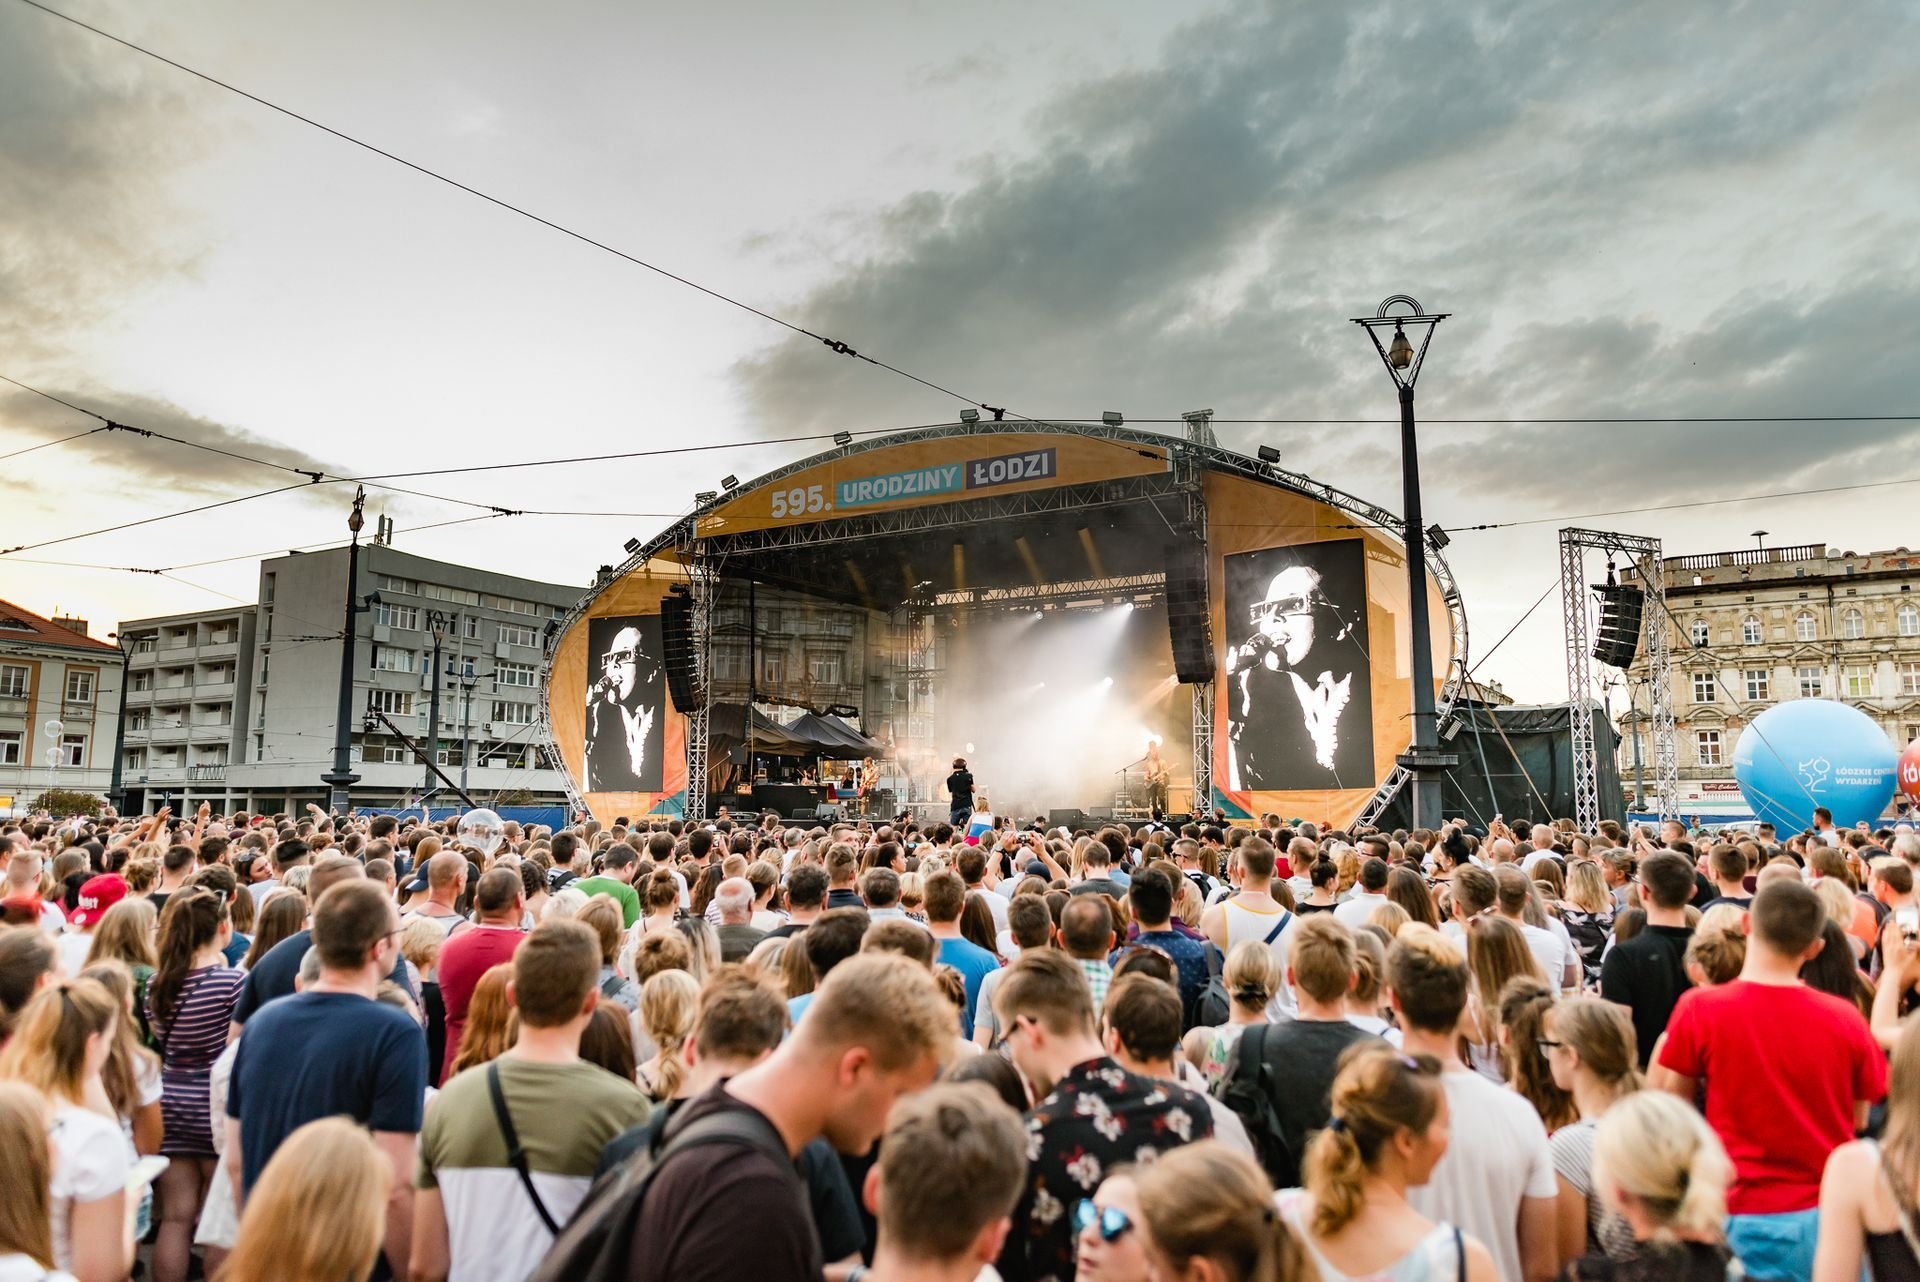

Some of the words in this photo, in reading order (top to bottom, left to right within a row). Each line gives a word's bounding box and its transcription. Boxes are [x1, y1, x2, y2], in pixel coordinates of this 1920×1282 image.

[770, 485, 833, 519] 595.
[843, 466, 959, 503] URODZINY
[973, 452, 1049, 485] ŁODZI
